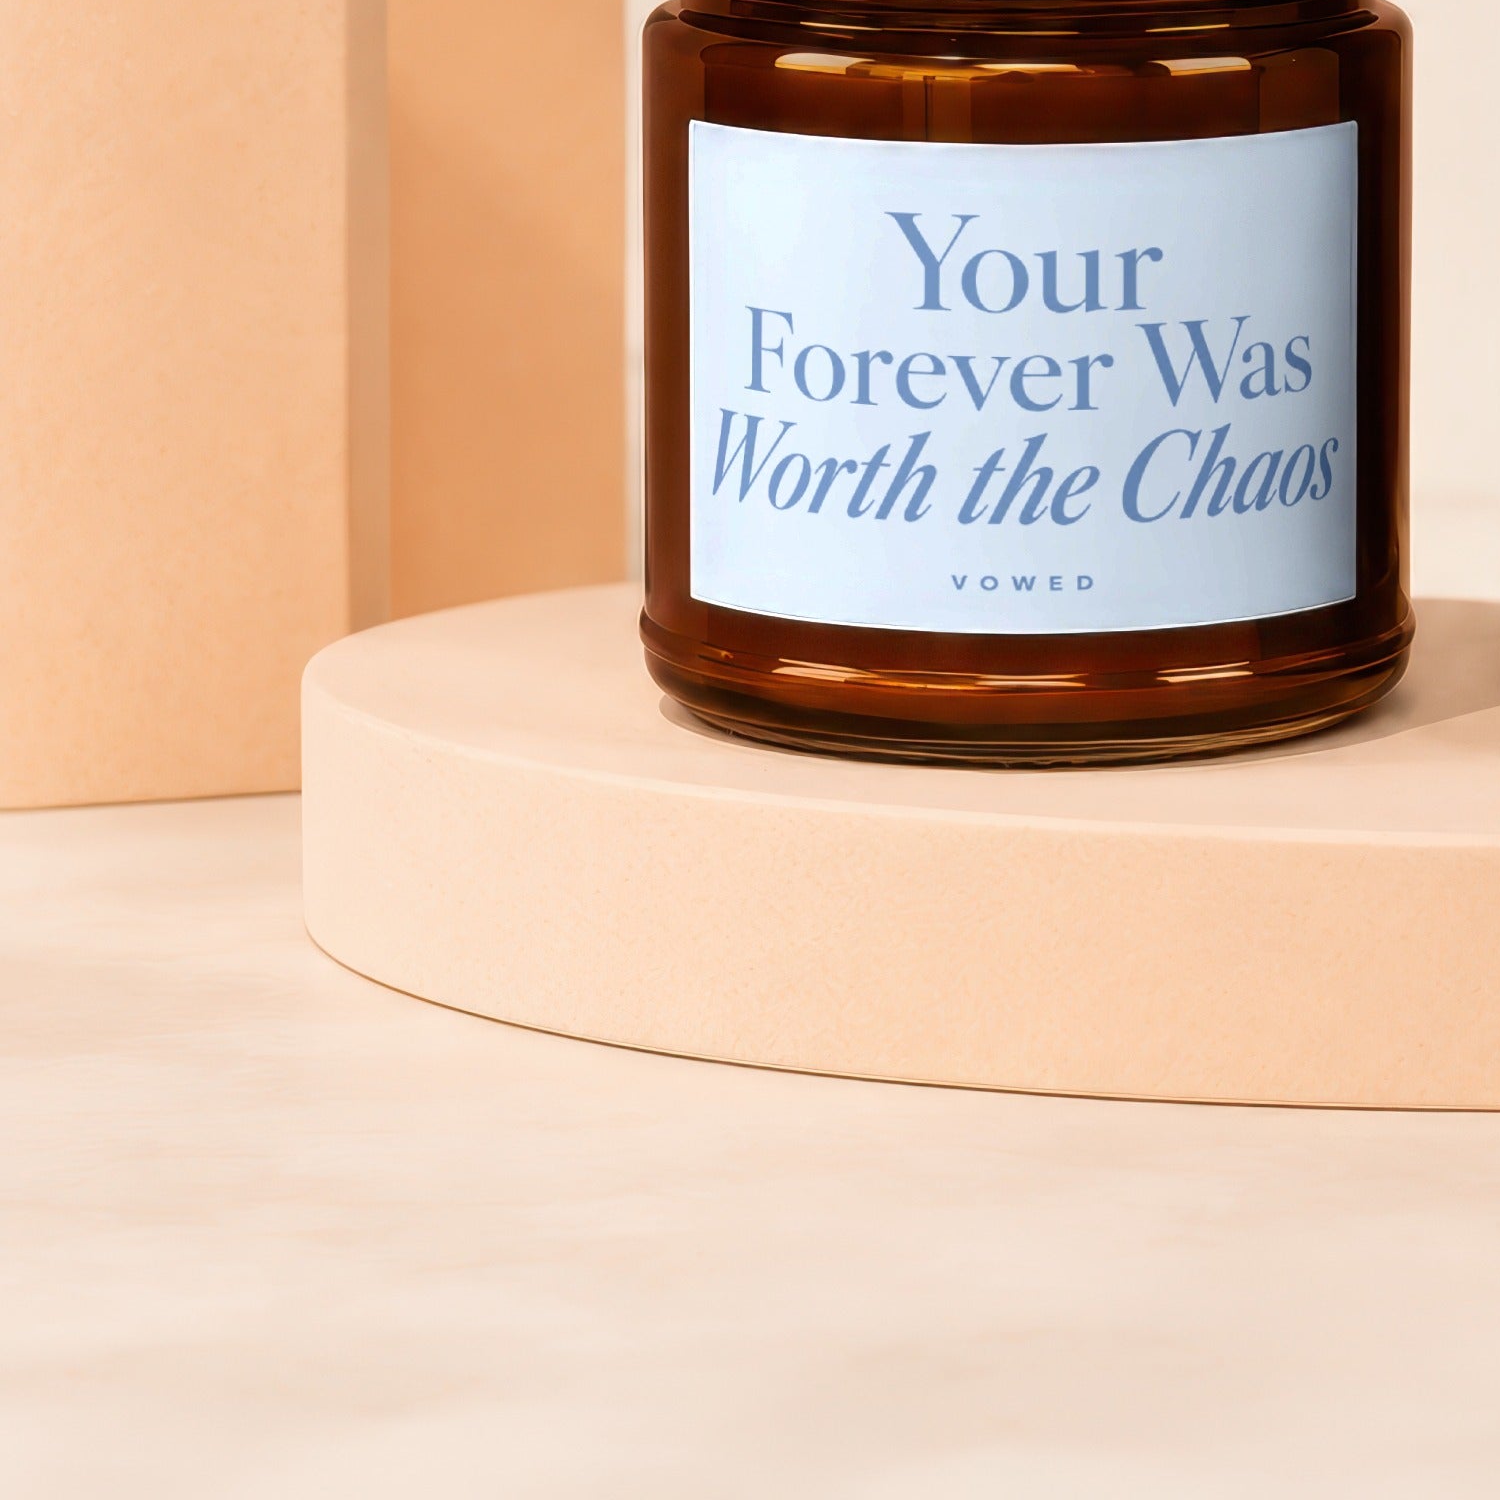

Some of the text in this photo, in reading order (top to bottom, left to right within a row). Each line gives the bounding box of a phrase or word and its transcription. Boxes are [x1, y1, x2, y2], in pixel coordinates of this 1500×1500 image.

[885, 211, 1165, 314] Your
[744, 305, 1314, 413] Forever Was
[711, 407, 1340, 527] Worth the Chaos
[951, 574, 1095, 592] VOWED
